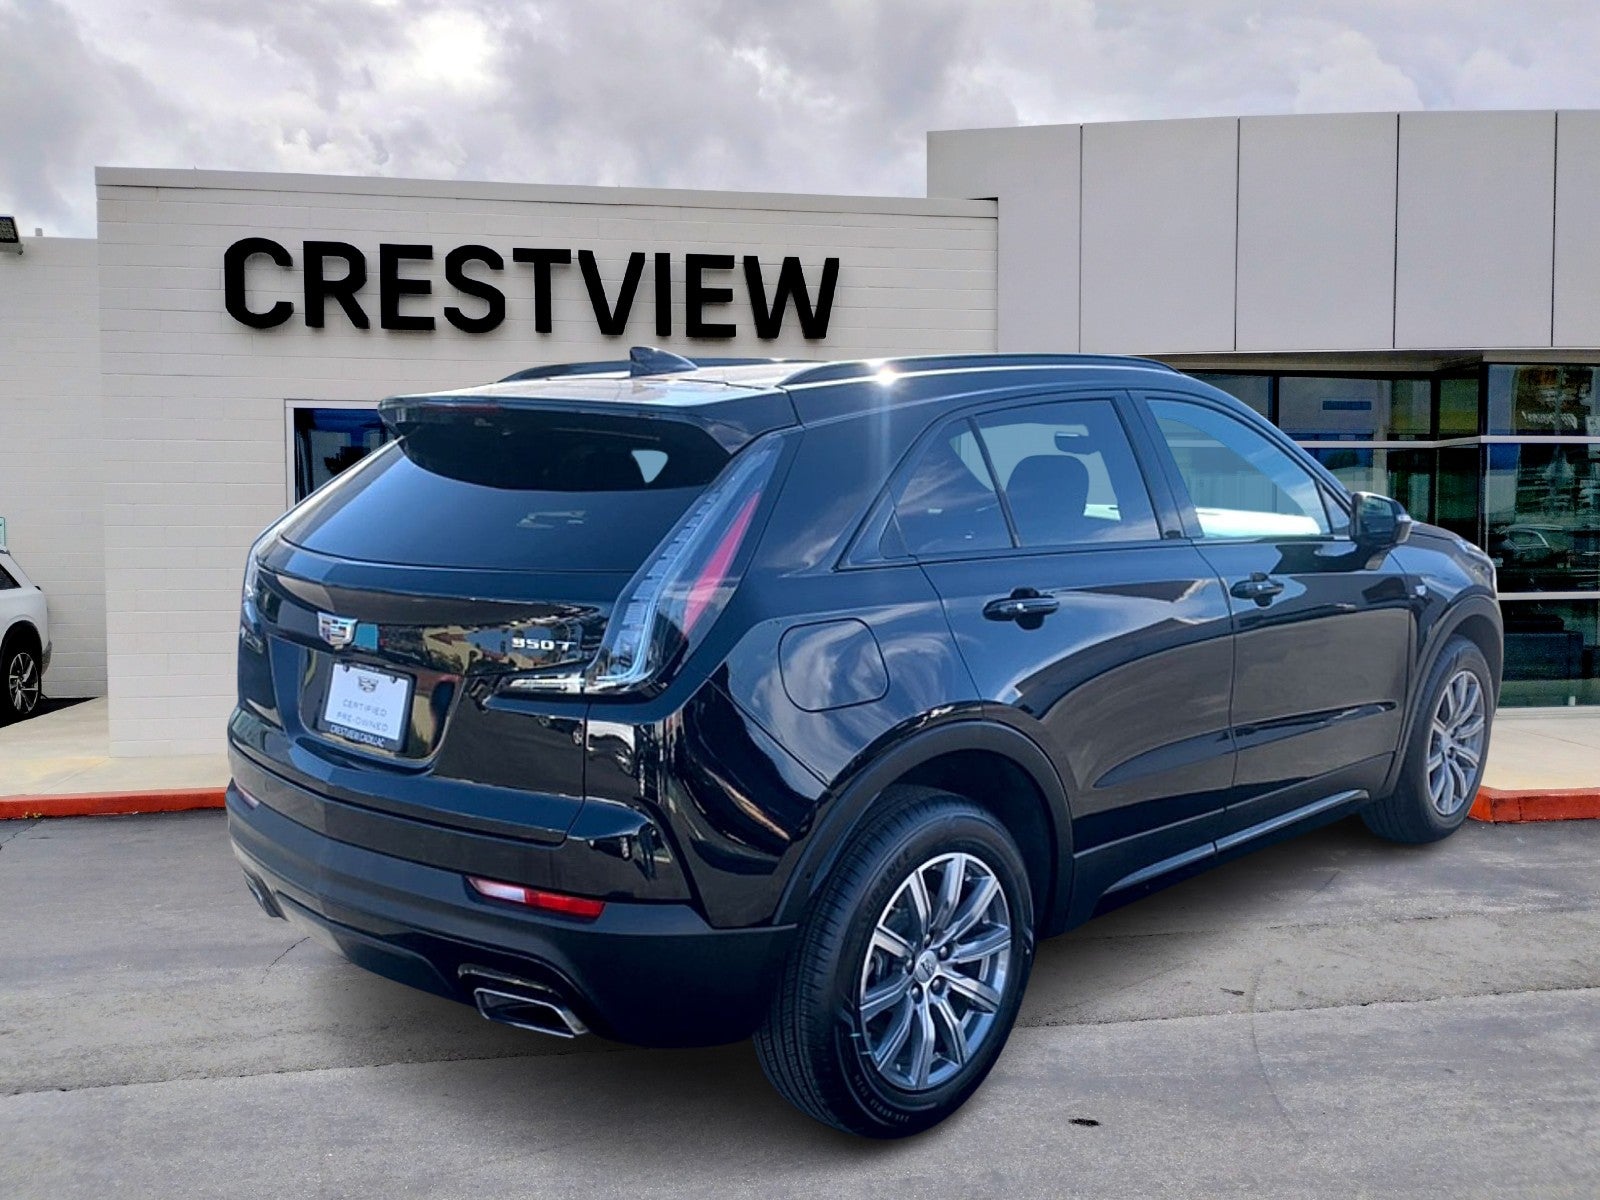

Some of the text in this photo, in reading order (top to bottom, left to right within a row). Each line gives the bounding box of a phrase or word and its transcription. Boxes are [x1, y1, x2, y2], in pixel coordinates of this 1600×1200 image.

[223, 237, 840, 340] CRESTVIEW
[342, 699, 388, 717] CERTIFIED
[336, 711, 389, 733] PRE-OWNED
